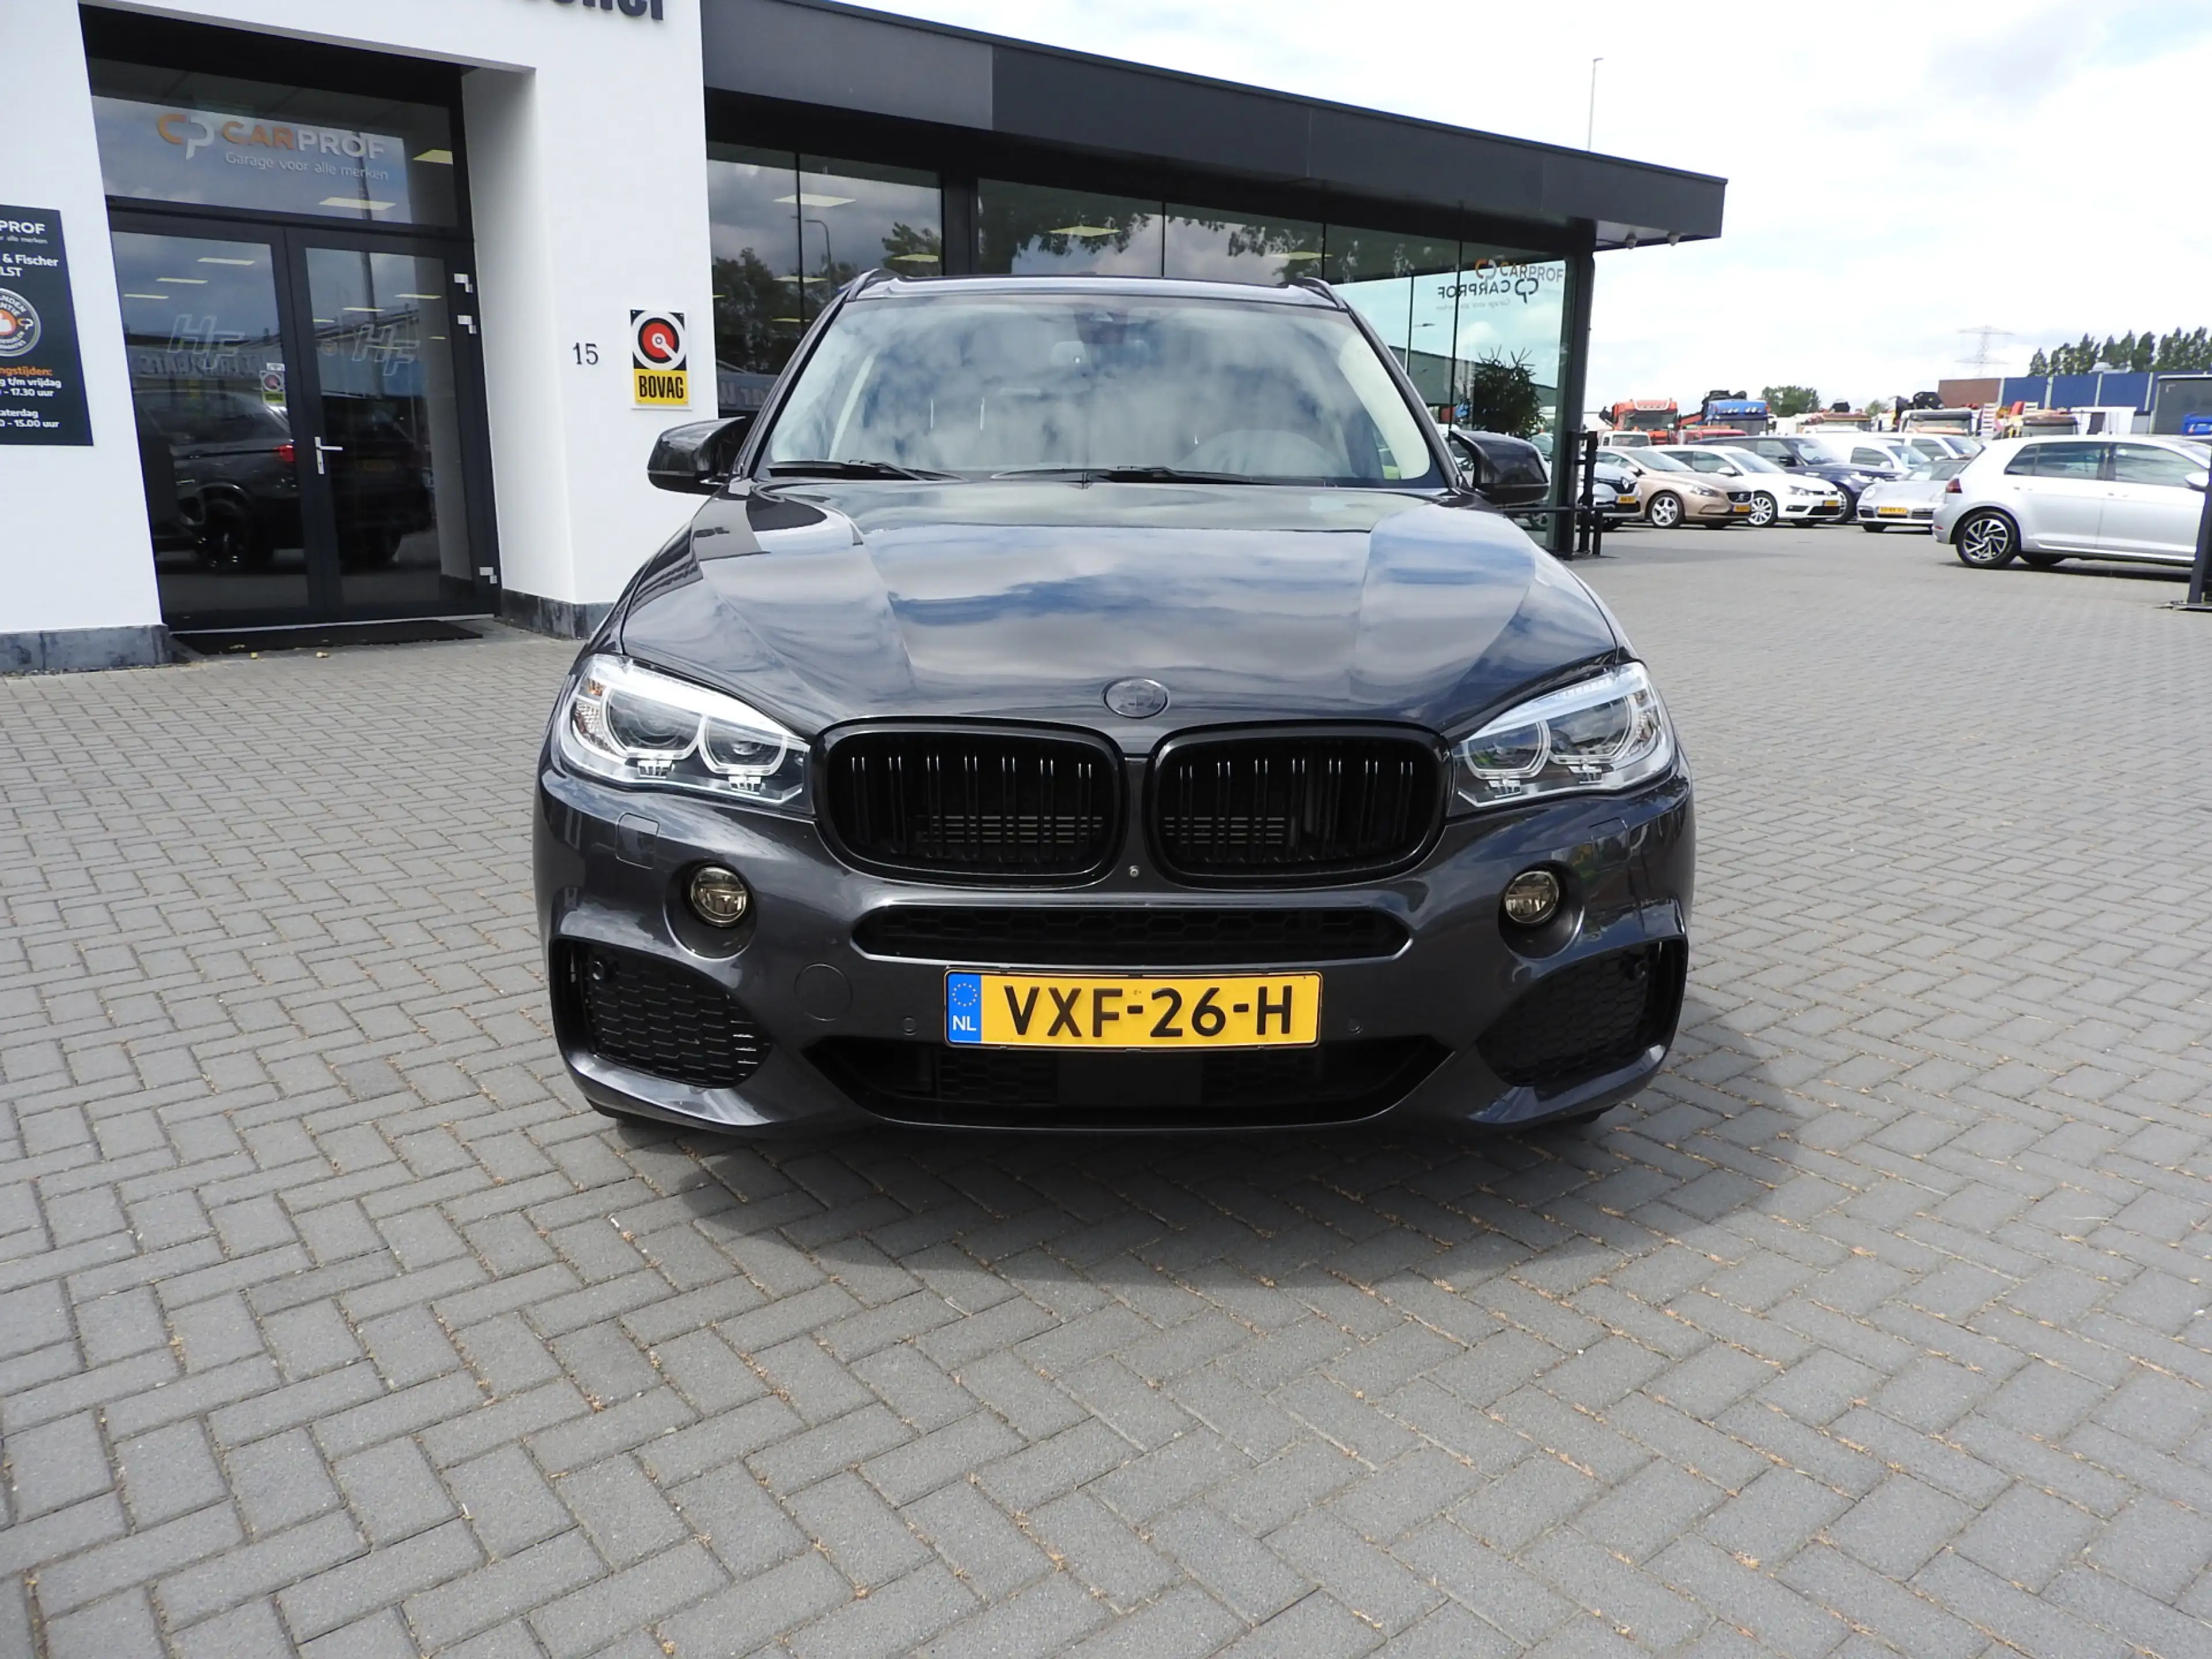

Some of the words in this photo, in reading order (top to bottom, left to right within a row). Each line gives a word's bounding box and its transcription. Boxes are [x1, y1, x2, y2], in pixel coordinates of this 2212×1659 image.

[222, 120, 385, 160] CARPROF
[225, 151, 274, 170] Garage
[278, 160, 309, 171] voor
[315, 161, 337, 176] alle
[340, 166, 389, 181] merken
[2, 253, 13, 263] &
[15, 254, 59, 267] Fischer
[1499, 262, 1564, 282] CARPROF
[573, 342, 599, 365] 15
[10, 388, 36, 396] 17.30
[27, 378, 62, 388] vrijdag
[638, 375, 684, 399] BOVAG
[1003, 984, 1293, 1037] VXF-26-H
[952, 1014, 977, 1032] NL
